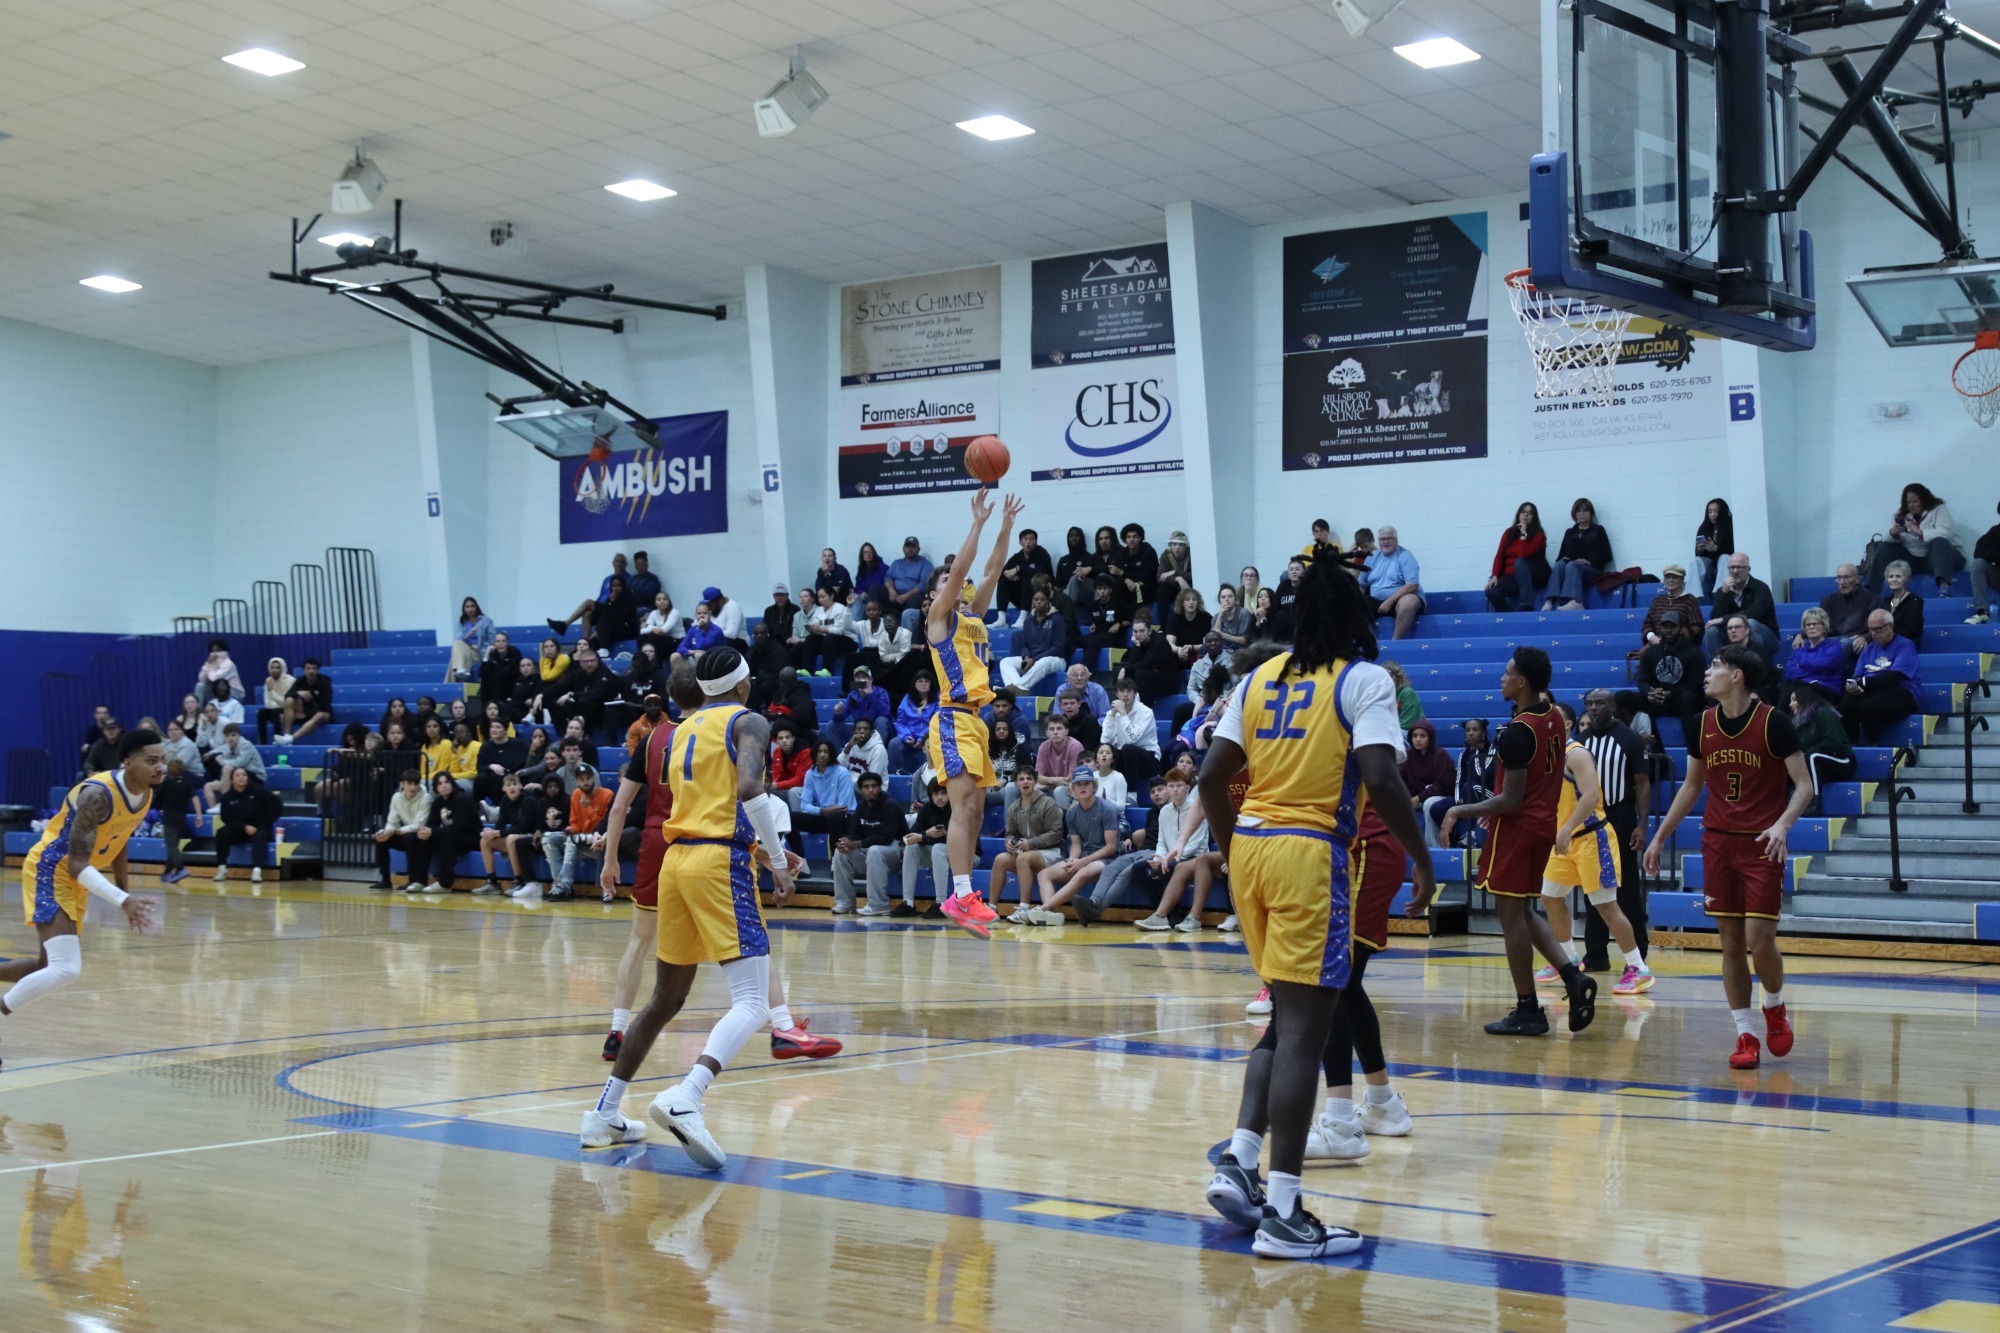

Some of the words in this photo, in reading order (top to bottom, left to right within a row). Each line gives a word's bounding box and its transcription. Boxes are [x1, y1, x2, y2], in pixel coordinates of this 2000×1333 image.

[1407, 243, 1440, 253] CONSULTING
[1407, 253, 1440, 263] LEADERSHIP
[874, 289, 892, 300] The
[1405, 290, 1426, 299] Virtual
[856, 300, 912, 321] STONE
[916, 291, 987, 312] CHIMNEY
[927, 329, 945, 340] Gifts
[946, 328, 954, 337] &
[955, 327, 974, 336] More
[1328, 334, 1352, 342] PROUD
[1353, 330, 1394, 340] SUPPORTER
[1428, 323, 1467, 333] ATHLETICS
[1071, 352, 1092, 360] PROUD
[1093, 347, 1128, 357] SUPPORTER
[1158, 342, 1175, 350] ATHL
[1648, 351, 1679, 359] SOLUTIONS
[1649, 376, 1712, 391] 620-755-6763
[1075, 379, 1161, 428] CHS
[1322, 391, 1371, 404] HILLSBORO
[1534, 402, 1569, 413] JUSTIN
[1631, 391, 1693, 405] 620-755-7970
[862, 400, 975, 423] FarmersAlliance
[1321, 399, 1373, 415] ANIMAL
[1729, 392, 1756, 422] B
[1328, 410, 1364, 423] CLINIC
[1534, 421, 1546, 430] PO
[1548, 420, 1567, 429] BOX
[1624, 413, 1636, 423] KS
[1337, 426, 1363, 439] Jessica
[1363, 425, 1375, 435] M.
[1375, 423, 1409, 433] Shearer,
[1410, 421, 1429, 431] DVM
[1369, 435, 1384, 445] Holly
[1384, 434, 1398, 442] Road
[1428, 431, 1447, 440] Kansas
[1328, 454, 1351, 462] PROUD
[1353, 450, 1394, 460] SUPPORTER
[1395, 449, 1405, 457] OF
[1406, 448, 1427, 456] TIGER
[1428, 446, 1467, 455] ATHLETICS
[575, 455, 712, 502] AMBUSH
[1070, 469, 1091, 477] PROUD
[1092, 466, 1128, 475] SUPPORTER
[763, 469, 779, 492] C
[894, 481, 926, 490] SUPPORTER
[427, 497, 441, 518] D
[1256, 680, 1316, 740] 32
[683, 733, 697, 781] 1
[1706, 749, 1761, 769] HESSTON
[1726, 772, 1742, 802] 3
